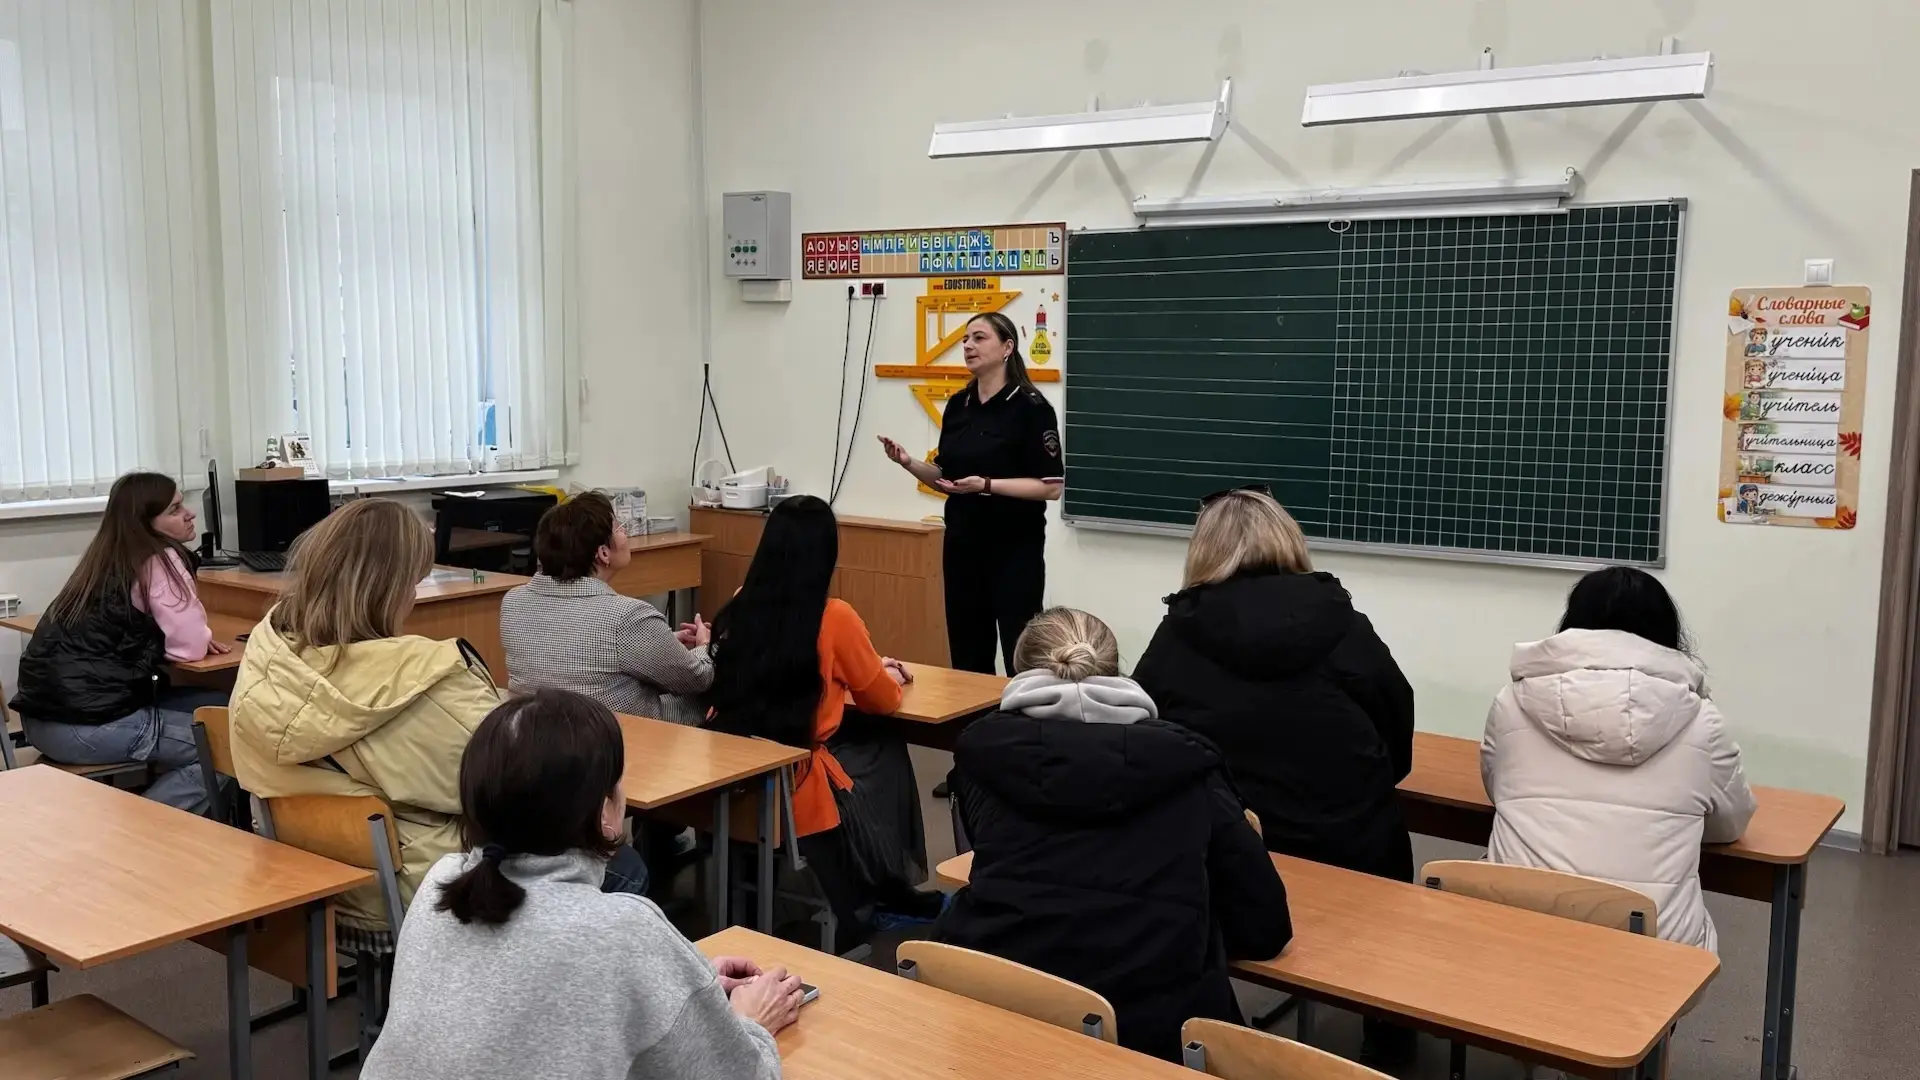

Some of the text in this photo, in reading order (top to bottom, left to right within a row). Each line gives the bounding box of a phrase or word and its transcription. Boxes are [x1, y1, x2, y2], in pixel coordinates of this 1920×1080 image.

[1757, 296, 1846, 314] Словарные
[1778, 310, 1825, 325] слова
[1774, 462, 1834, 475] класс
